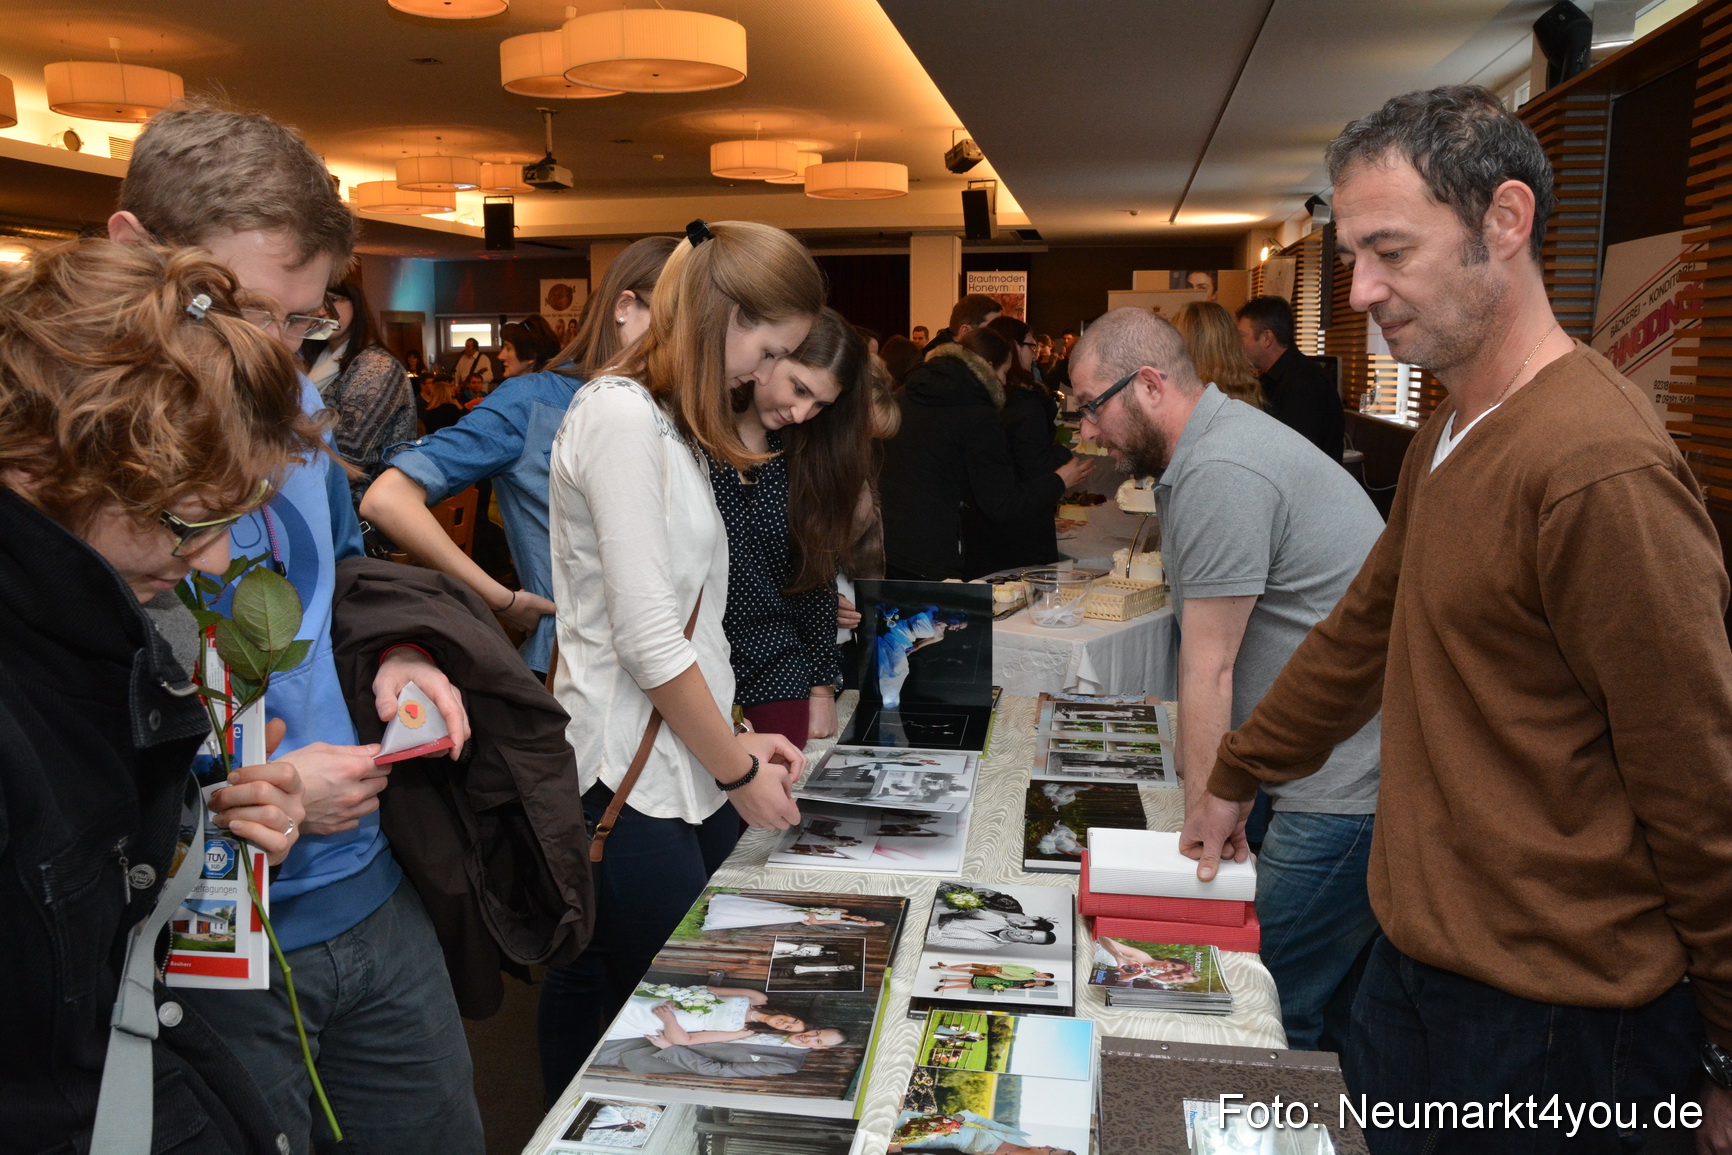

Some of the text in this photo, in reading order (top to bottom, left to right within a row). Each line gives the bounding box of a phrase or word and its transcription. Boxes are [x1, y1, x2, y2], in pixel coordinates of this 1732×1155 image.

[969, 284, 1024, 293] Honeymoon
[1609, 303, 1641, 338] BÄCKEREI
[207, 853, 226, 862] TÜV
